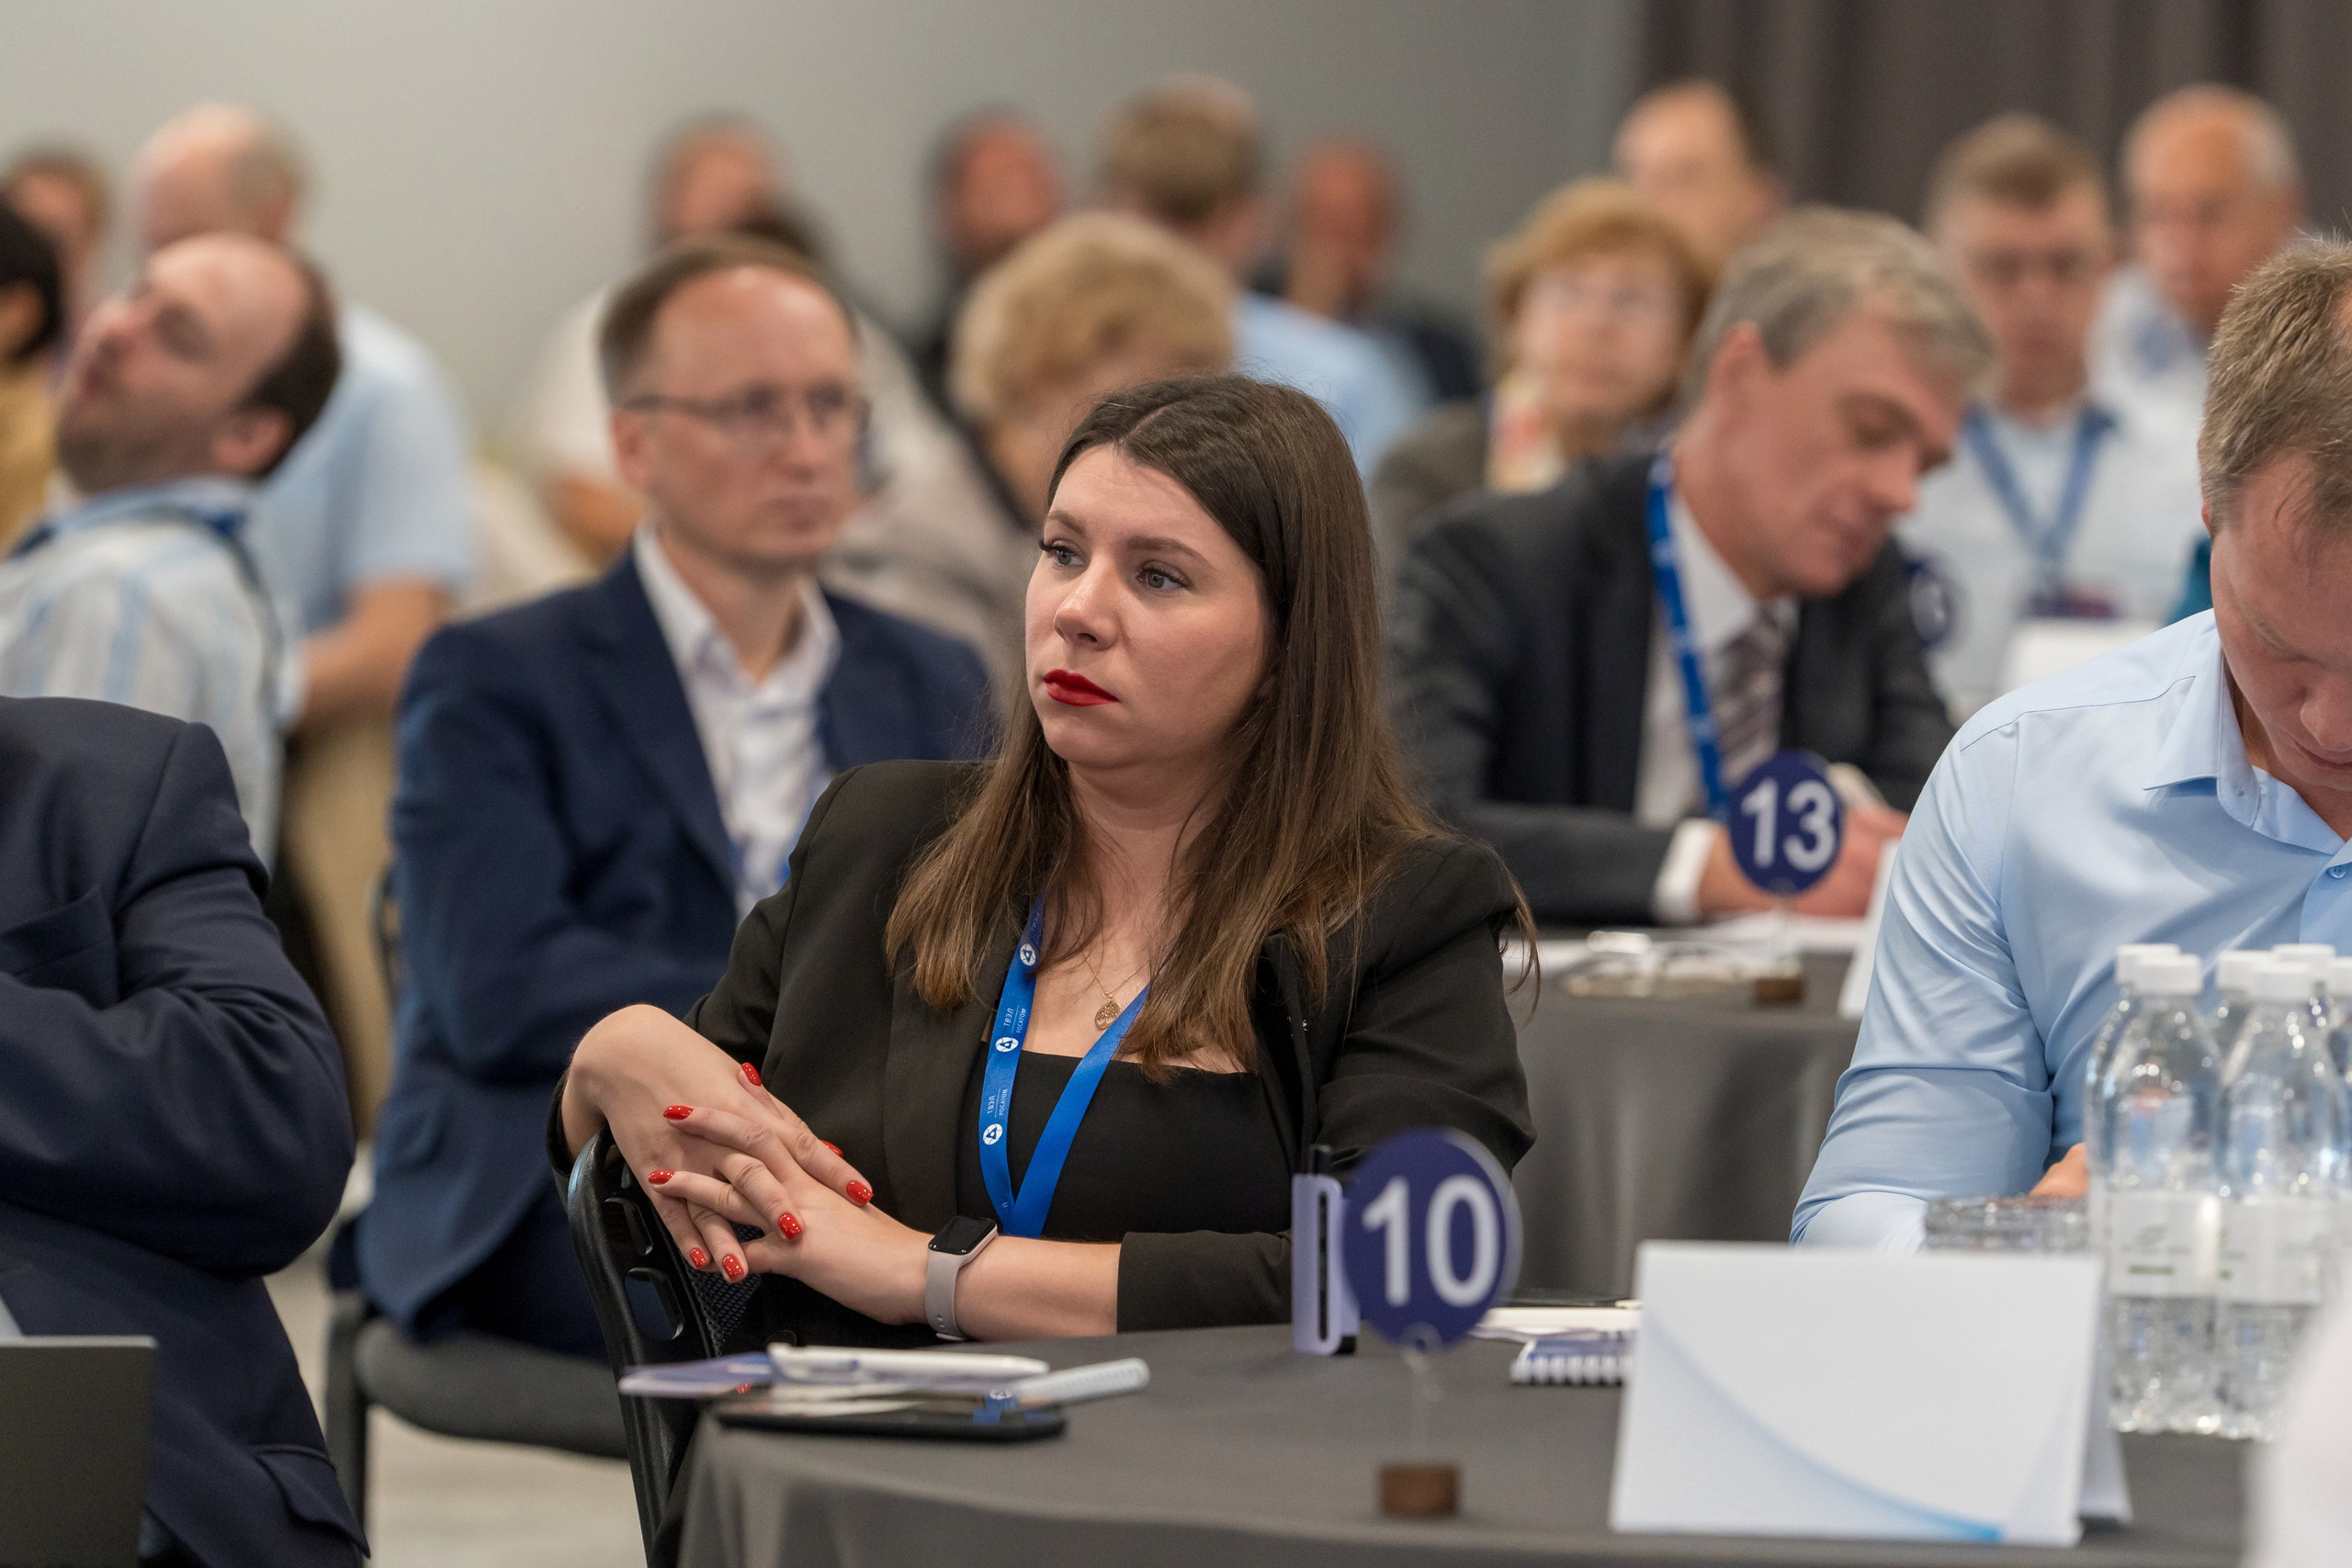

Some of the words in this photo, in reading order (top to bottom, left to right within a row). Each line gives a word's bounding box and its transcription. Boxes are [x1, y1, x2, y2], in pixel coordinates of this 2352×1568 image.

[1741, 777, 1837, 872] 13
[1016, 1008, 1026, 1033] РОСАТОМ
[999, 1088, 1008, 1116] РОСАТОМ
[1362, 1174, 1500, 1308] 10
